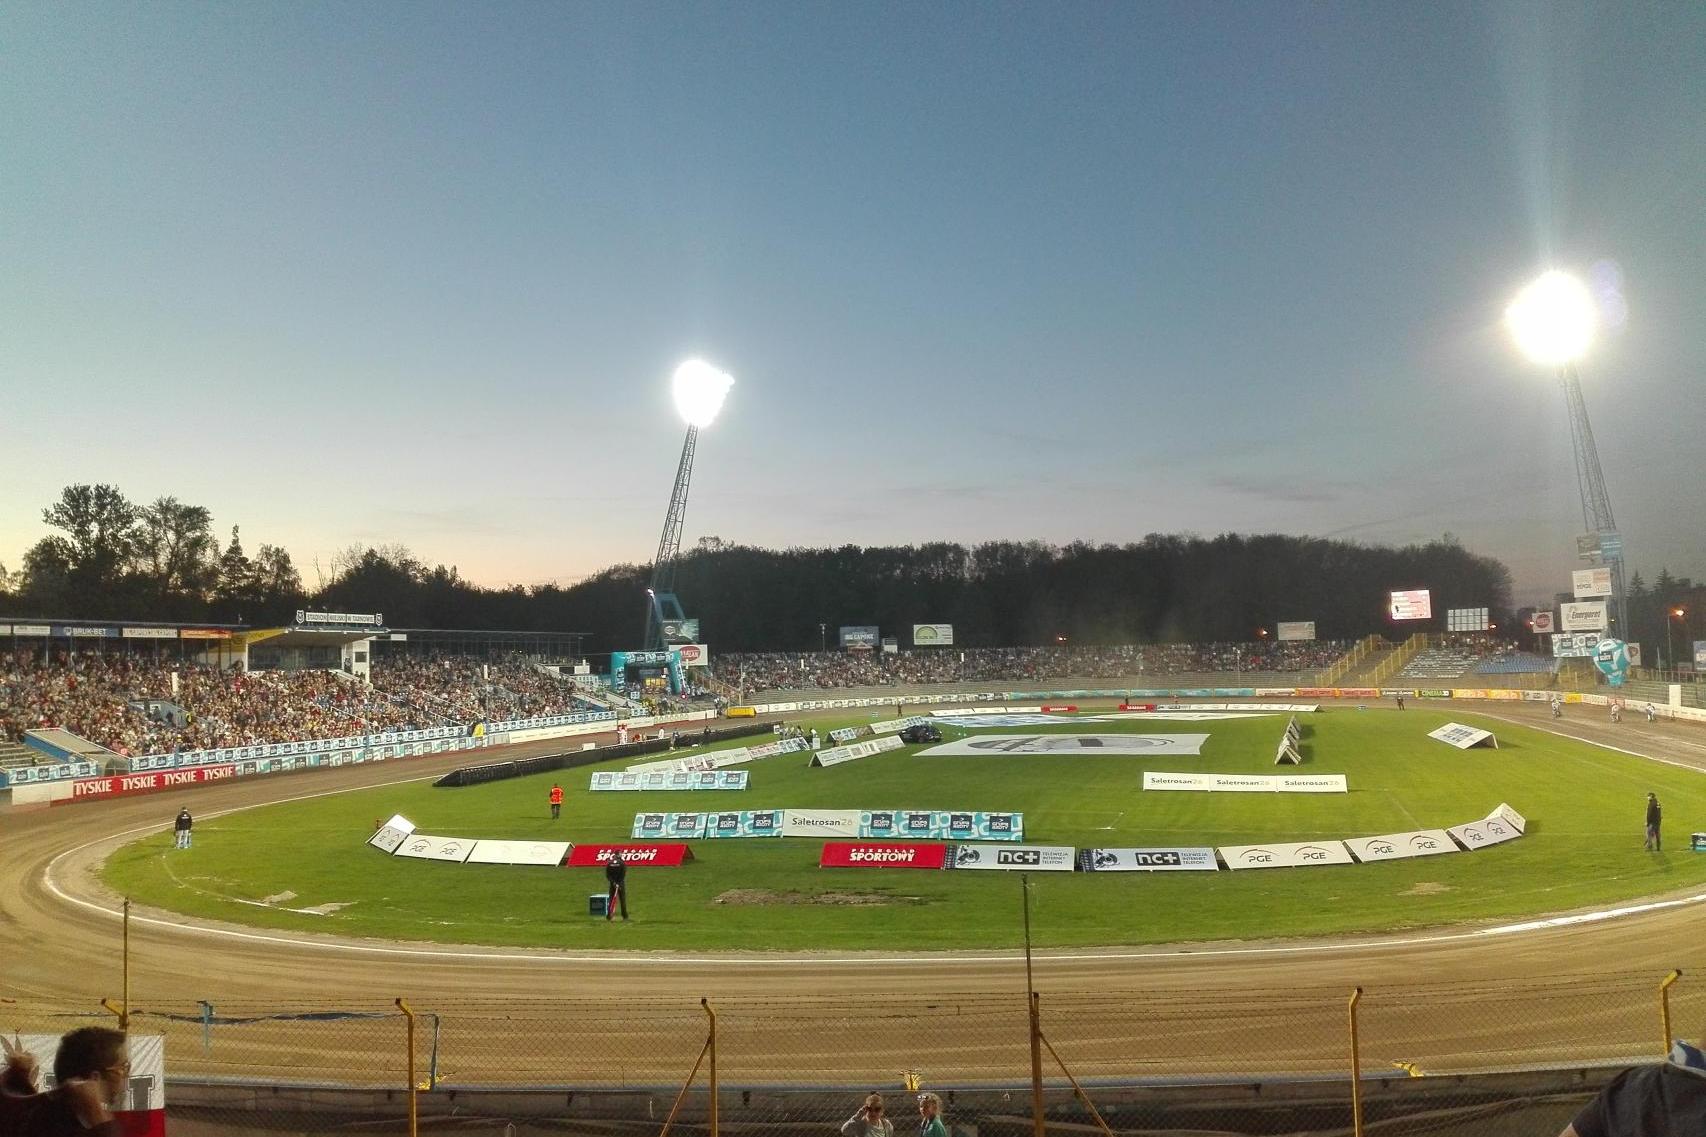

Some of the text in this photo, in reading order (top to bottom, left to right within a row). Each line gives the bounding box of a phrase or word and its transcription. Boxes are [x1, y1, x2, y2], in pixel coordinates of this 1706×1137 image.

[162, 770, 197, 785] TYSKIE
[203, 766, 234, 781] TYSKIE
[74, 780, 112, 795] TYSKIE
[121, 775, 156, 790] TYSKIE
[1373, 845, 1394, 855] PGE
[1416, 841, 1437, 850] PGE
[849, 852, 915, 862] SPORTOWY
[999, 850, 1038, 863] nc+
[1137, 853, 1178, 864] nc+
[1248, 855, 1273, 863] PGE
[1303, 852, 1327, 860] PGE
